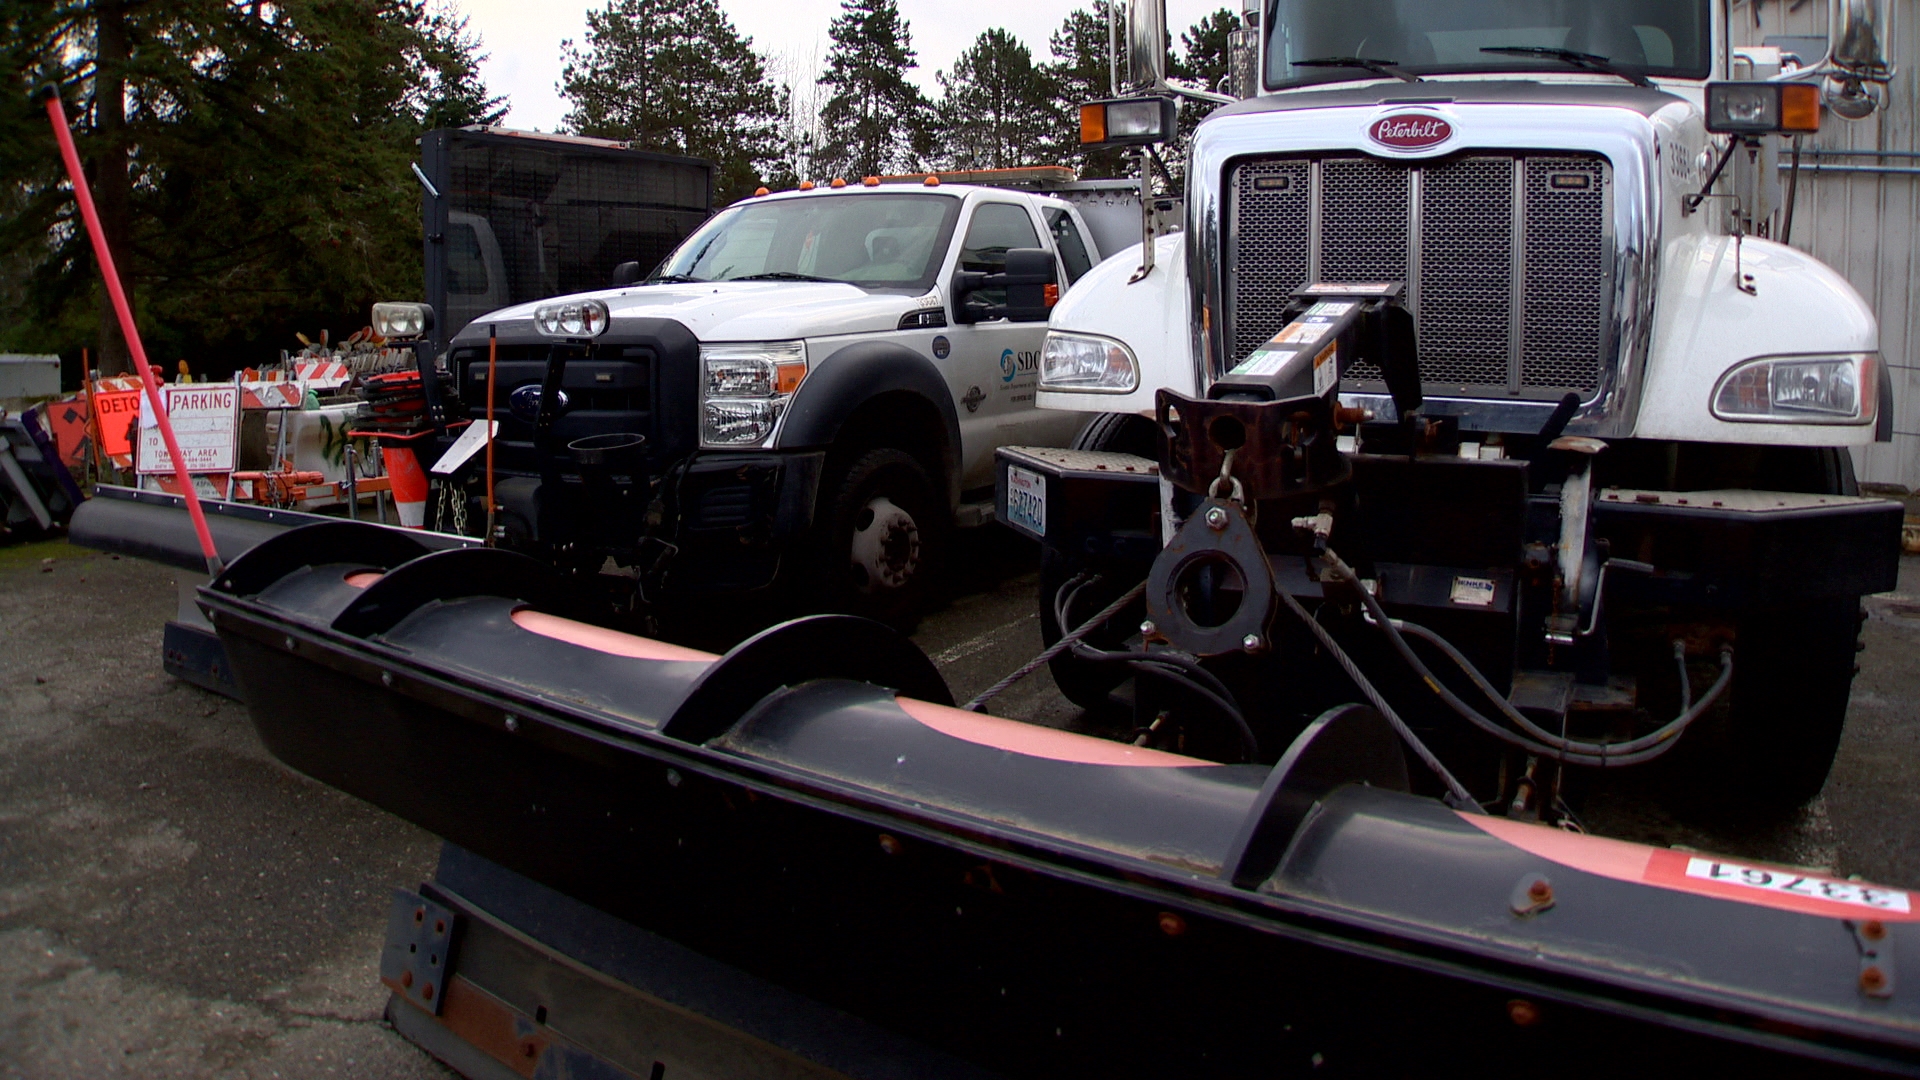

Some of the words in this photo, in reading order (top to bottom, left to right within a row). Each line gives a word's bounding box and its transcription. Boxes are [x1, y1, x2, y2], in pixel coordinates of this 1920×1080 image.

[1378, 120, 1444, 140] Peterbilt
[173, 392, 232, 411] PARKING
[148, 437, 159, 446] TO
[197, 448, 218, 457] AREA
[1709, 862, 1890, 908] 33761
